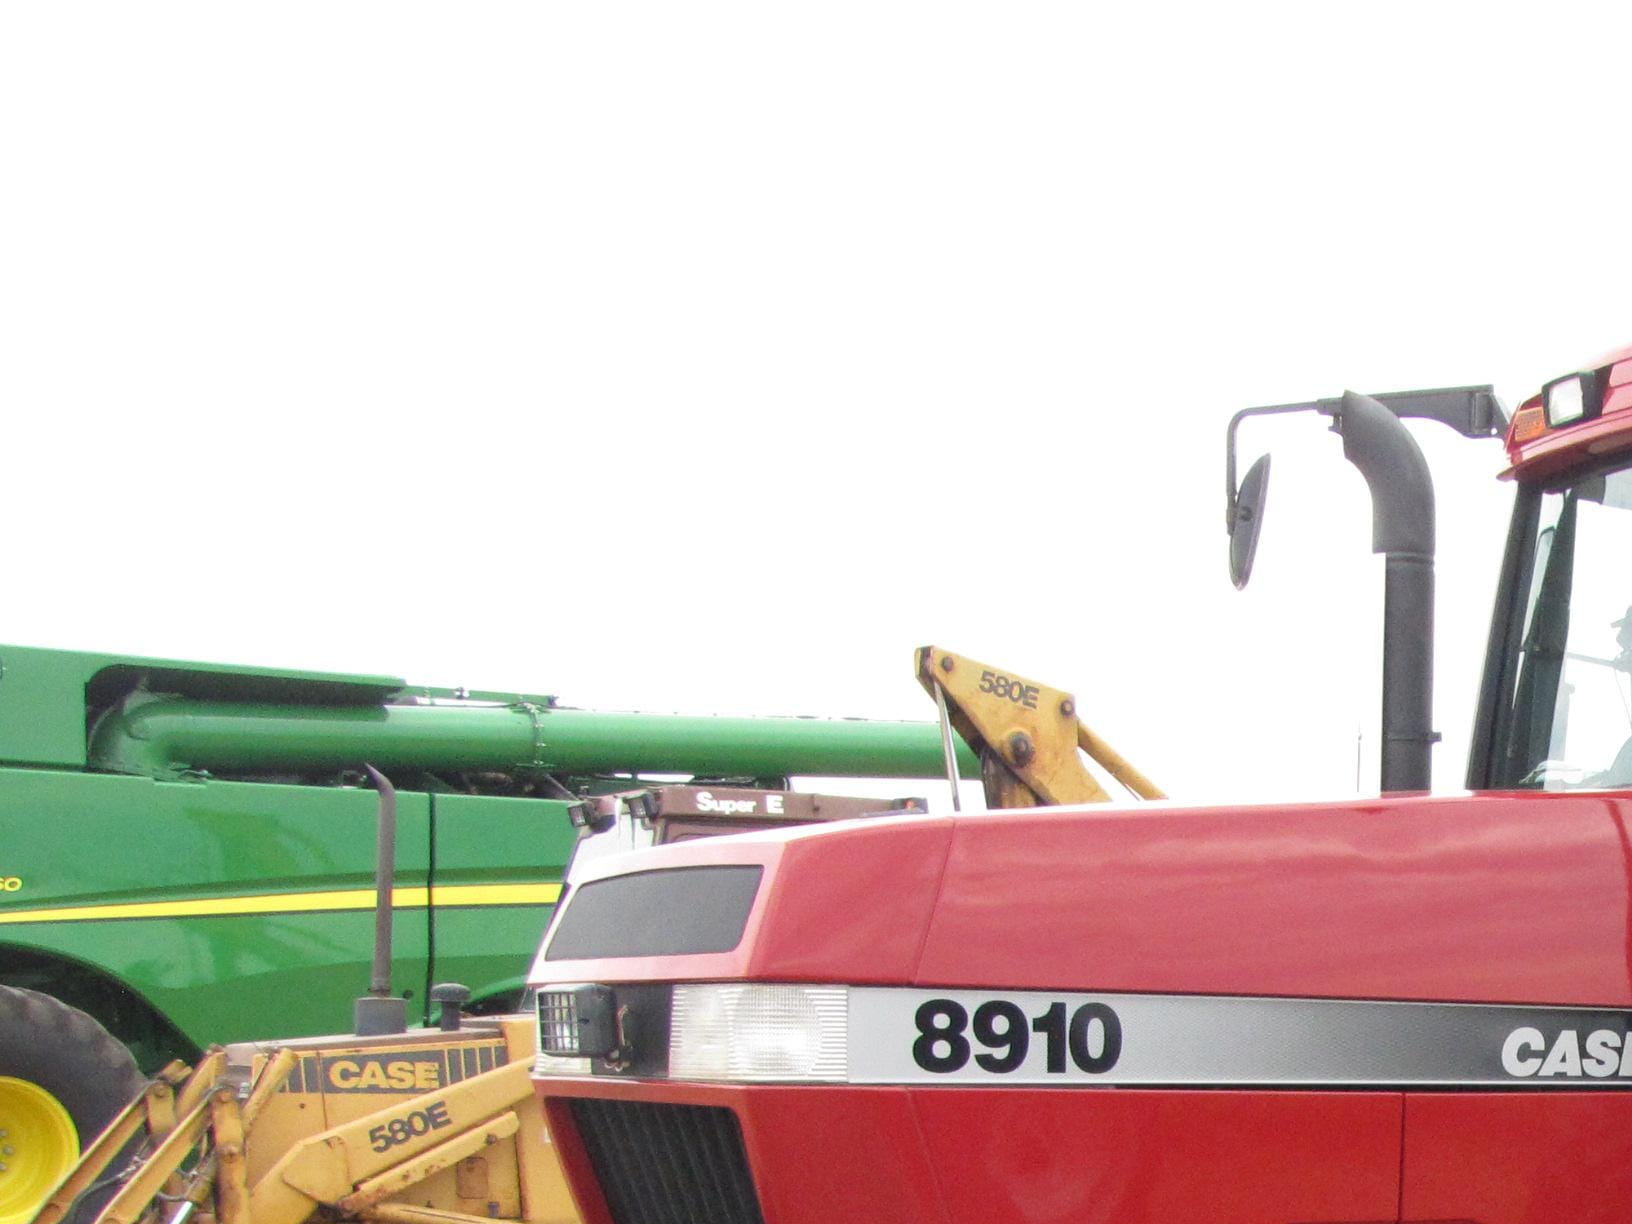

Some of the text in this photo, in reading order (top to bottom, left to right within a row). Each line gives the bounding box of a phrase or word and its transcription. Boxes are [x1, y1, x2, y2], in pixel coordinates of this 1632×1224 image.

[979, 670, 1040, 709] 580E
[696, 791, 784, 815] Super E
[912, 998, 1122, 1074] 8910
[328, 1060, 440, 1089] CASE
[368, 1100, 453, 1153] 580E
